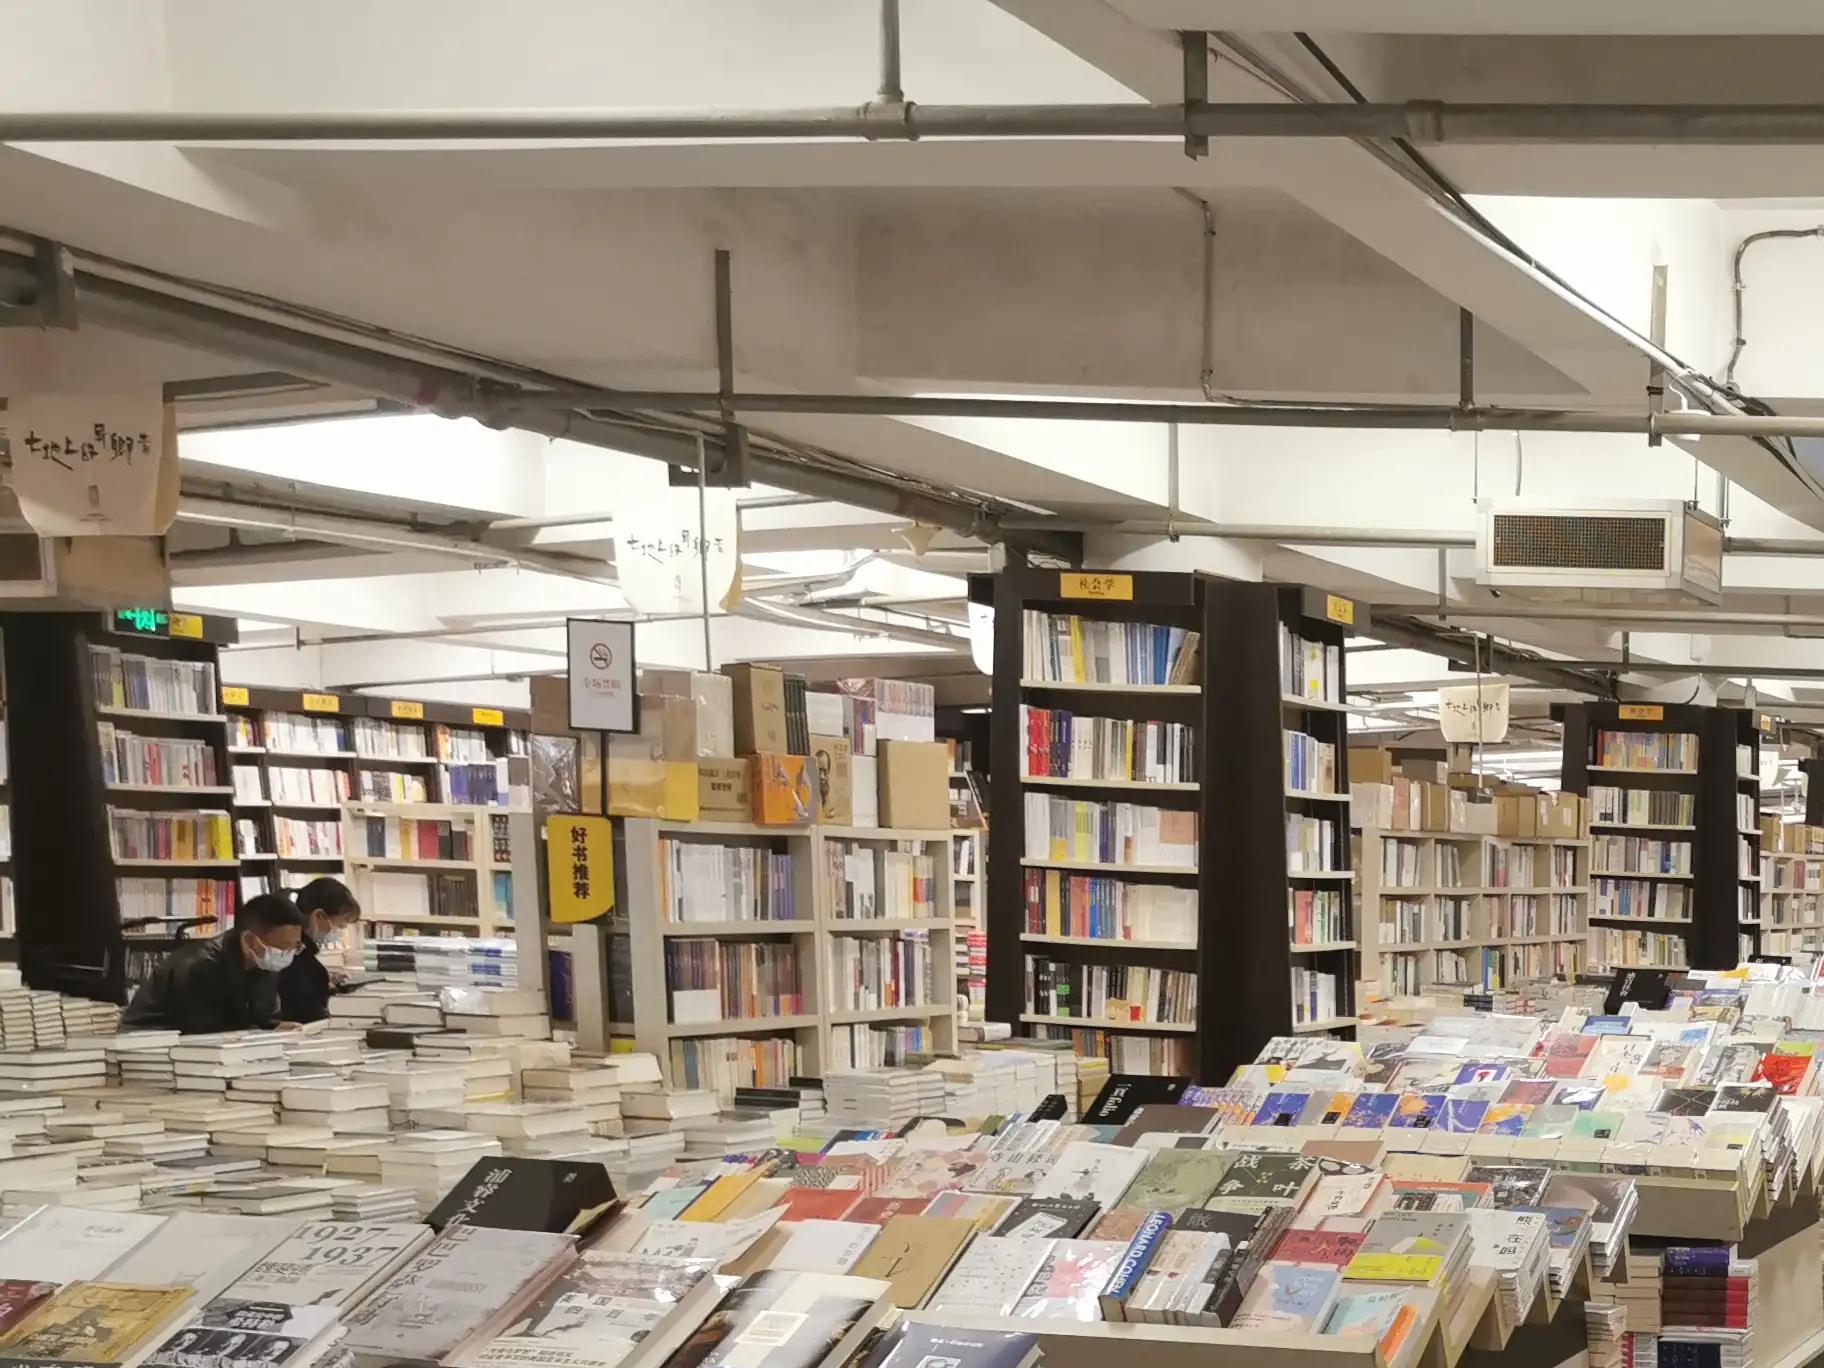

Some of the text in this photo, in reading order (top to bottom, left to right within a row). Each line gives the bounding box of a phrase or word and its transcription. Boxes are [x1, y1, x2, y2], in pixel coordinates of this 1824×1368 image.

[570, 826, 590, 899] 好书推荐
[301, 1246, 400, 1265] 1937
[1110, 1213, 1167, 1294] LEONARD COHEN
